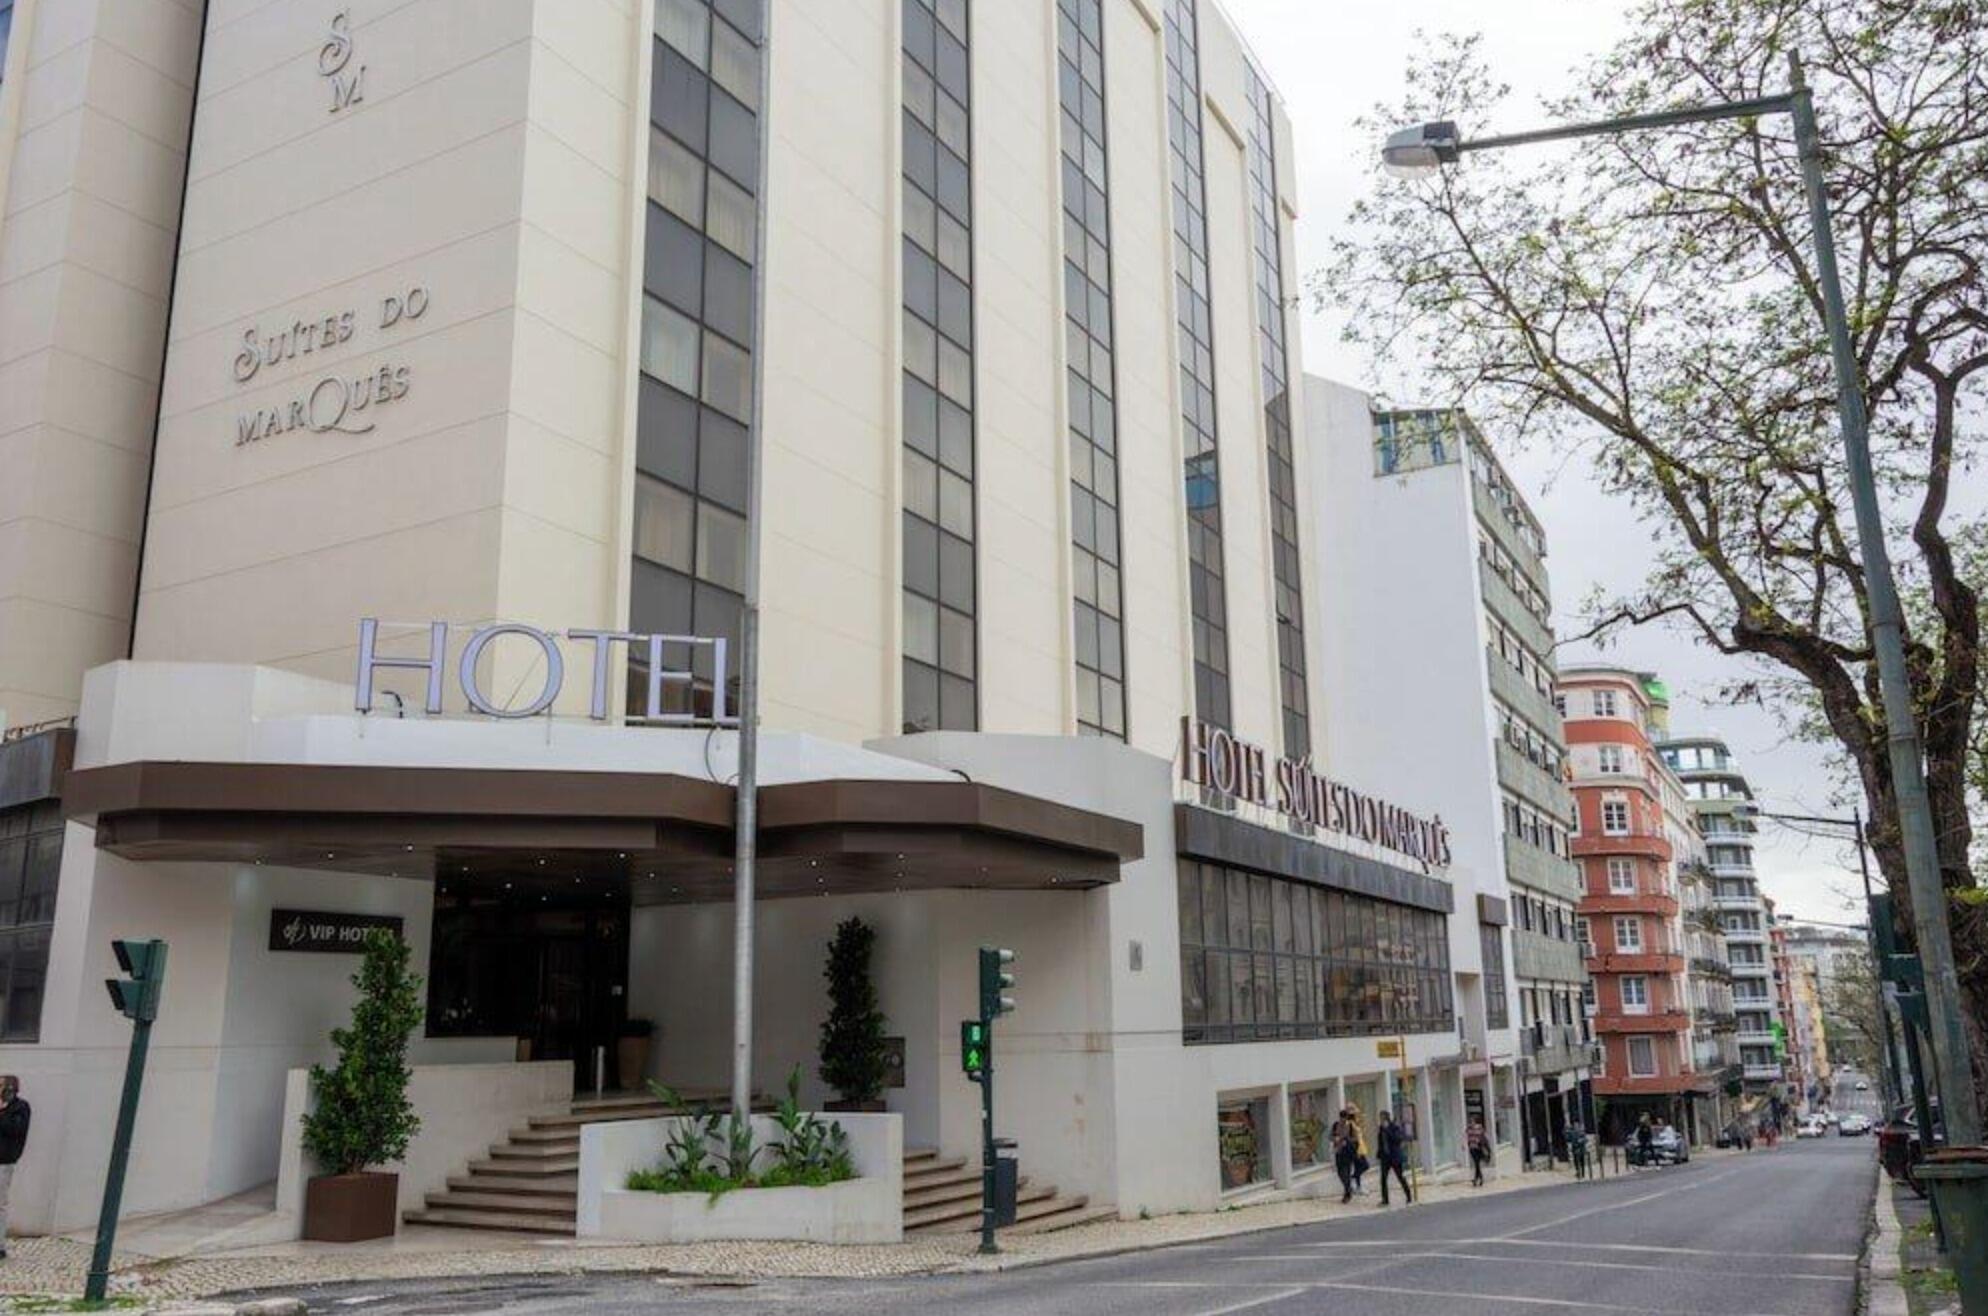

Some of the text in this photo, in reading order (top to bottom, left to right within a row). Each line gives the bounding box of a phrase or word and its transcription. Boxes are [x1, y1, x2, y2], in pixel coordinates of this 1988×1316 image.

[319, 8, 353, 77] S
[329, 66, 366, 113] M
[379, 286, 430, 330] DO
[355, 618, 759, 726] HOTEL
[309, 924, 395, 943] VIP HOT
